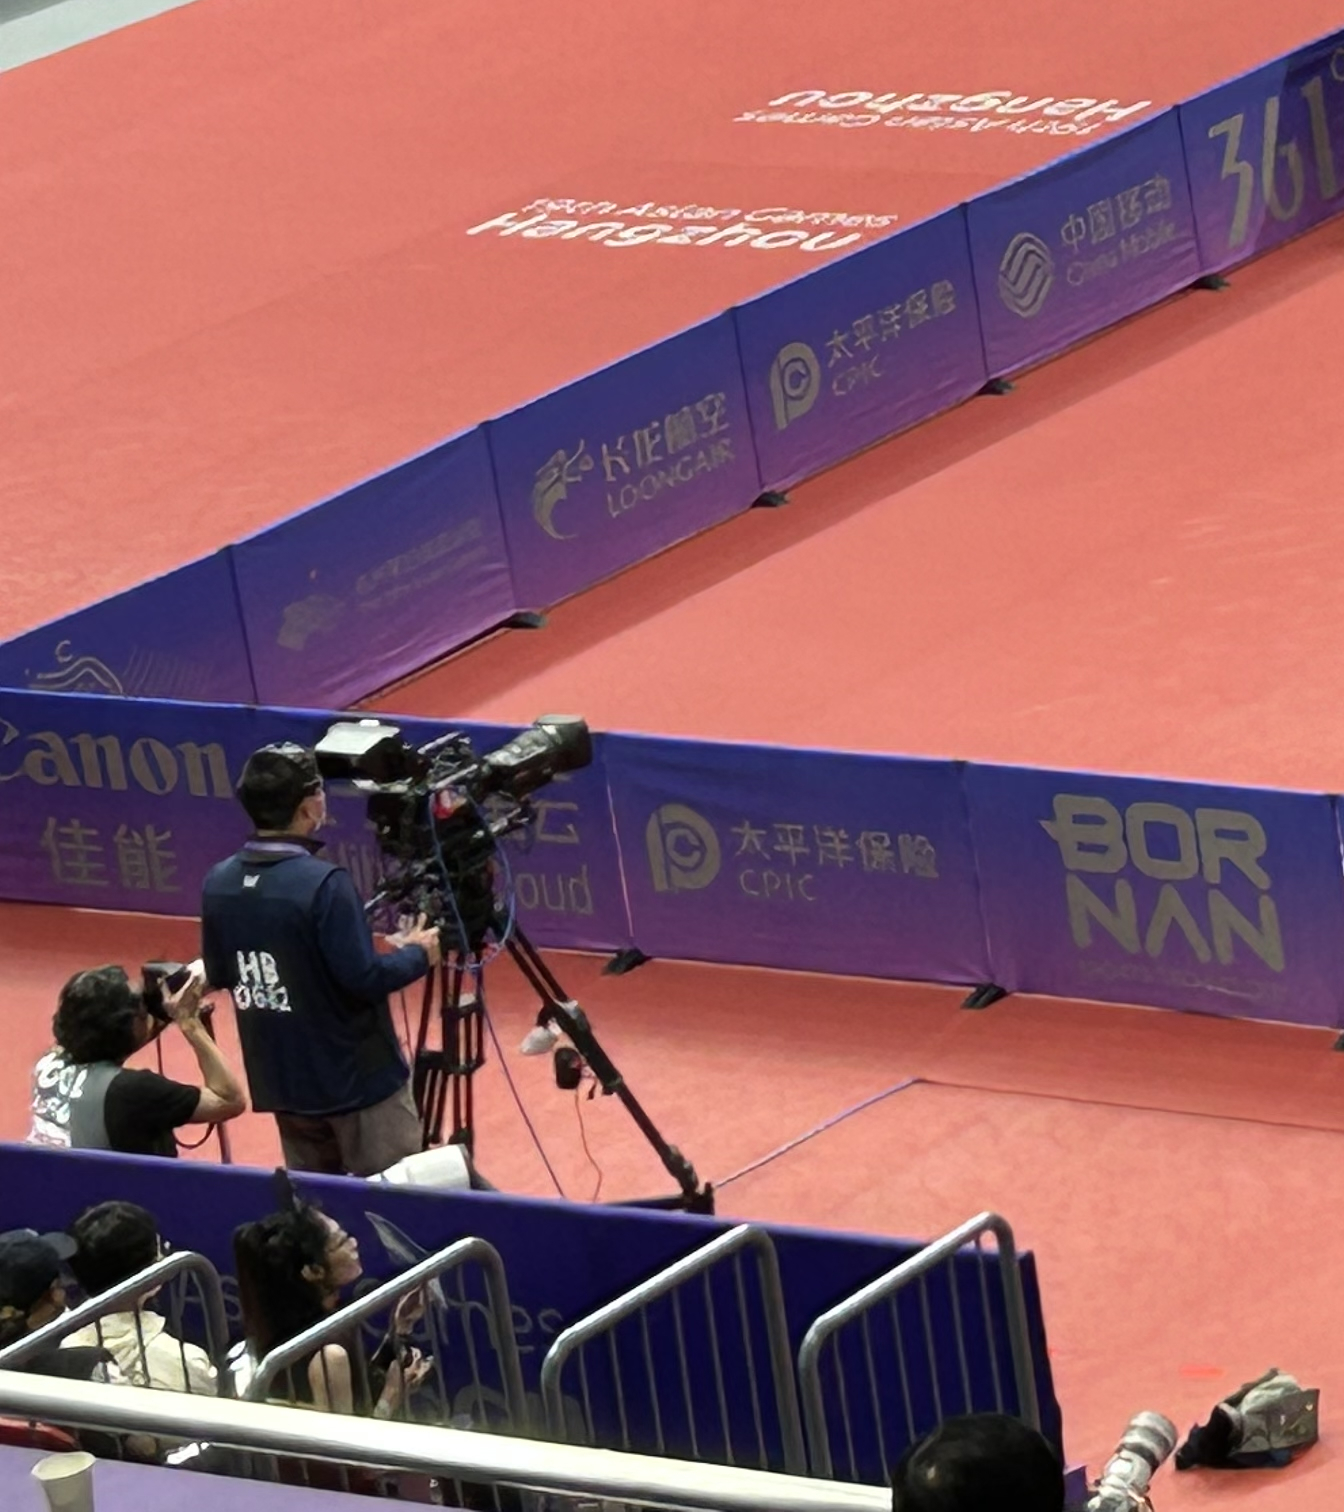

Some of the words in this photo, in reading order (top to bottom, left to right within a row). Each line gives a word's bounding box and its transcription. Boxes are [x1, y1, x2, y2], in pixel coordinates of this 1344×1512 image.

[767, 89, 1151, 122] Hangzhou
[468, 212, 861, 252] Hangzhou
[607, 437, 736, 518] LOONGAIR
[41, 817, 183, 892] 佳能
[730, 819, 939, 878] 太平洋保险
[1041, 793, 1271, 889] BOR
[740, 868, 818, 903] CPIC
[1065, 874, 1285, 972] NAN
[237, 950, 279, 987] HB
